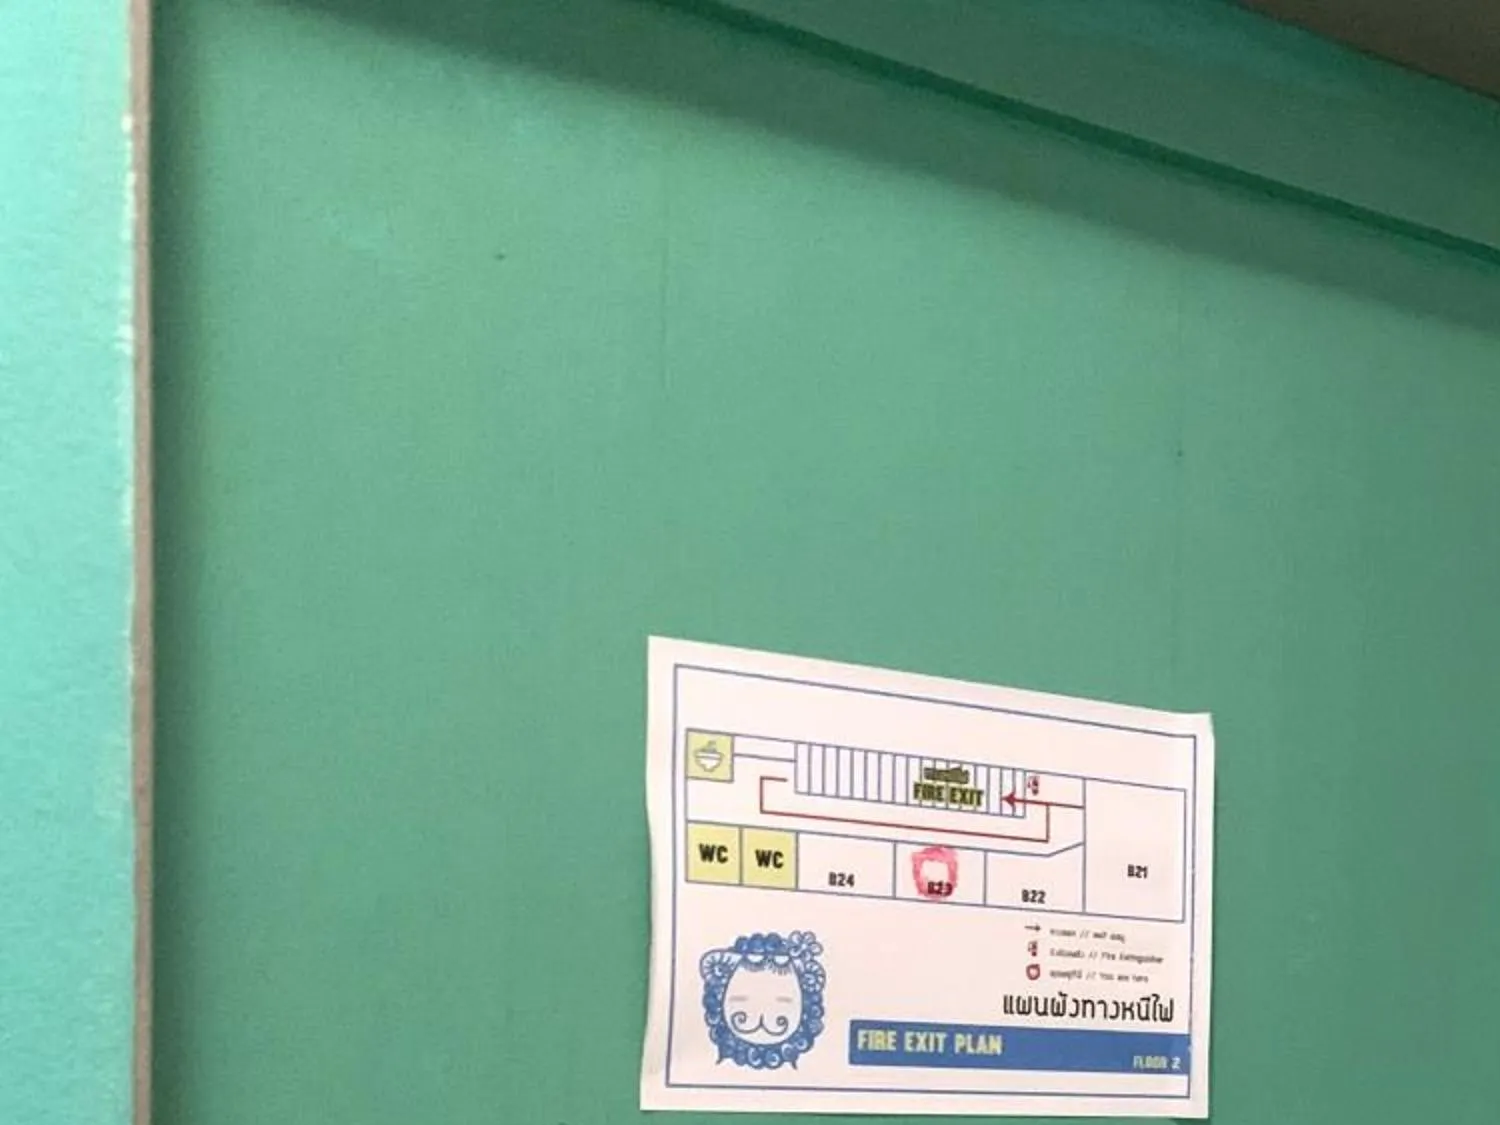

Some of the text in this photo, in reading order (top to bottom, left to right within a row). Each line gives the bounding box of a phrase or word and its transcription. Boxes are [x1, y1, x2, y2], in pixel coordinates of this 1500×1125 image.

[913, 782, 984, 806] FIRE EXIT
[699, 844, 728, 863] WC
[755, 849, 784, 869] WC
[828, 871, 855, 888] B24
[1127, 864, 1148, 879] B21
[1021, 889, 1046, 904] B22
[857, 1029, 1003, 1056] FIRE EXIT PLAN
[1133, 1055, 1181, 1069] FLOOR 2
